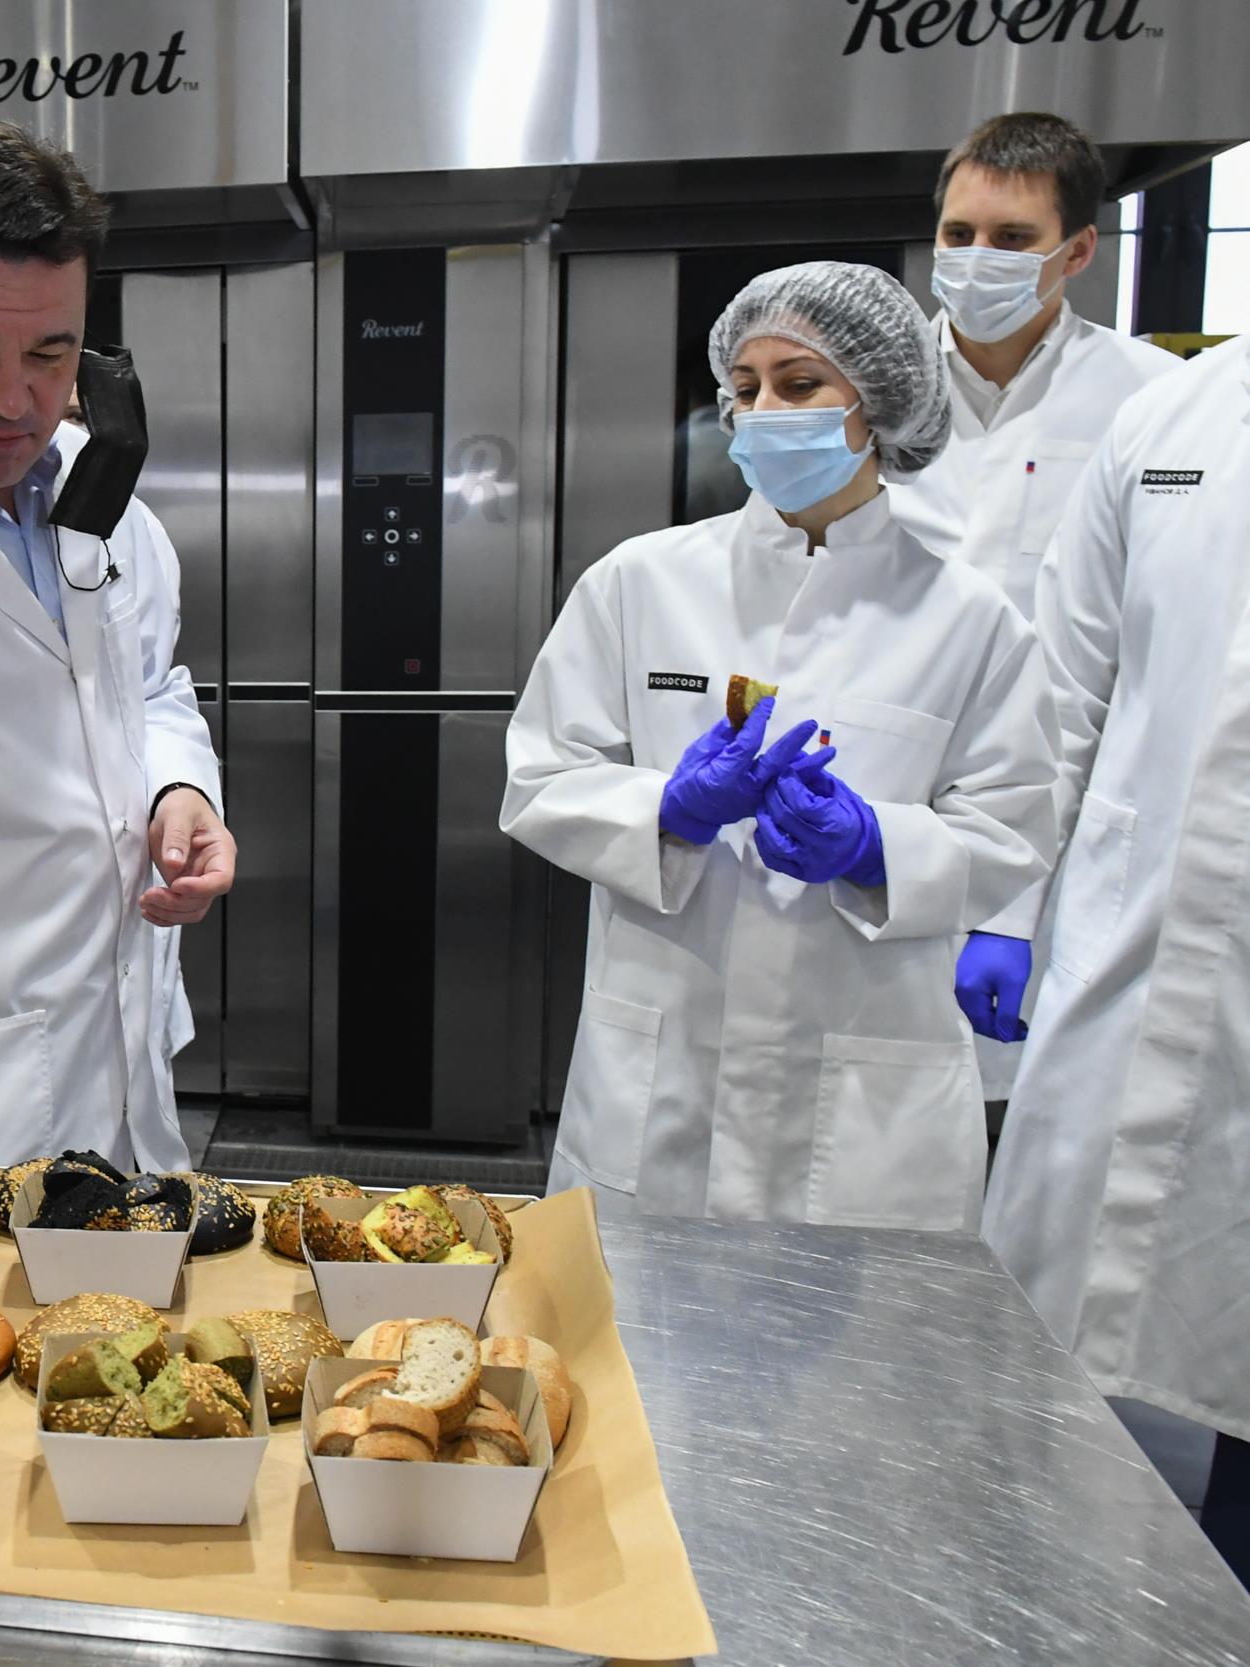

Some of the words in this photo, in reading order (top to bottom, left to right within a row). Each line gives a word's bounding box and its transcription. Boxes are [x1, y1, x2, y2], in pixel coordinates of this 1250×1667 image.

[361, 319, 424, 339] Revent
[1143, 472, 1199, 482] FOODCODE
[650, 676, 703, 689] FOODCODE
